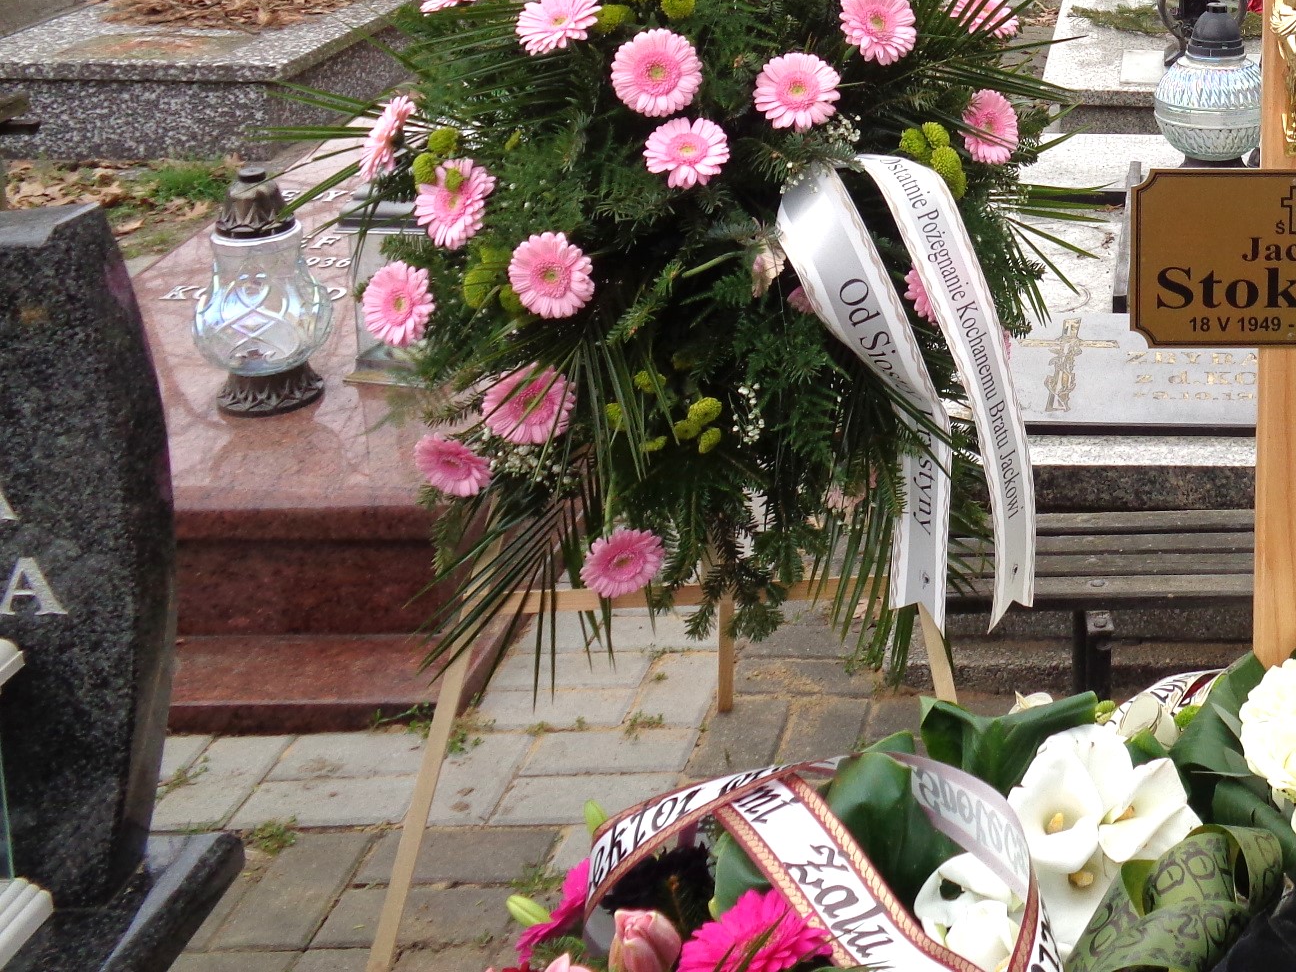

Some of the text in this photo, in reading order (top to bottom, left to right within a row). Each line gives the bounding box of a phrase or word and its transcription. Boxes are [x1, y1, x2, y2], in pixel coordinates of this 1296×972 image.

[840, 278, 881, 327] Od
[1189, 316, 1210, 332] 18
[1217, 316, 1231, 332] V
[1237, 316, 1281, 332] 1949
[917, 208, 970, 301] Pożegnanie
[956, 300, 998, 401] Kochanemu
[988, 400, 1010, 450] Bratu
[1000, 449, 1024, 519] Jackowi
[784, 843, 895, 959] Żalu
